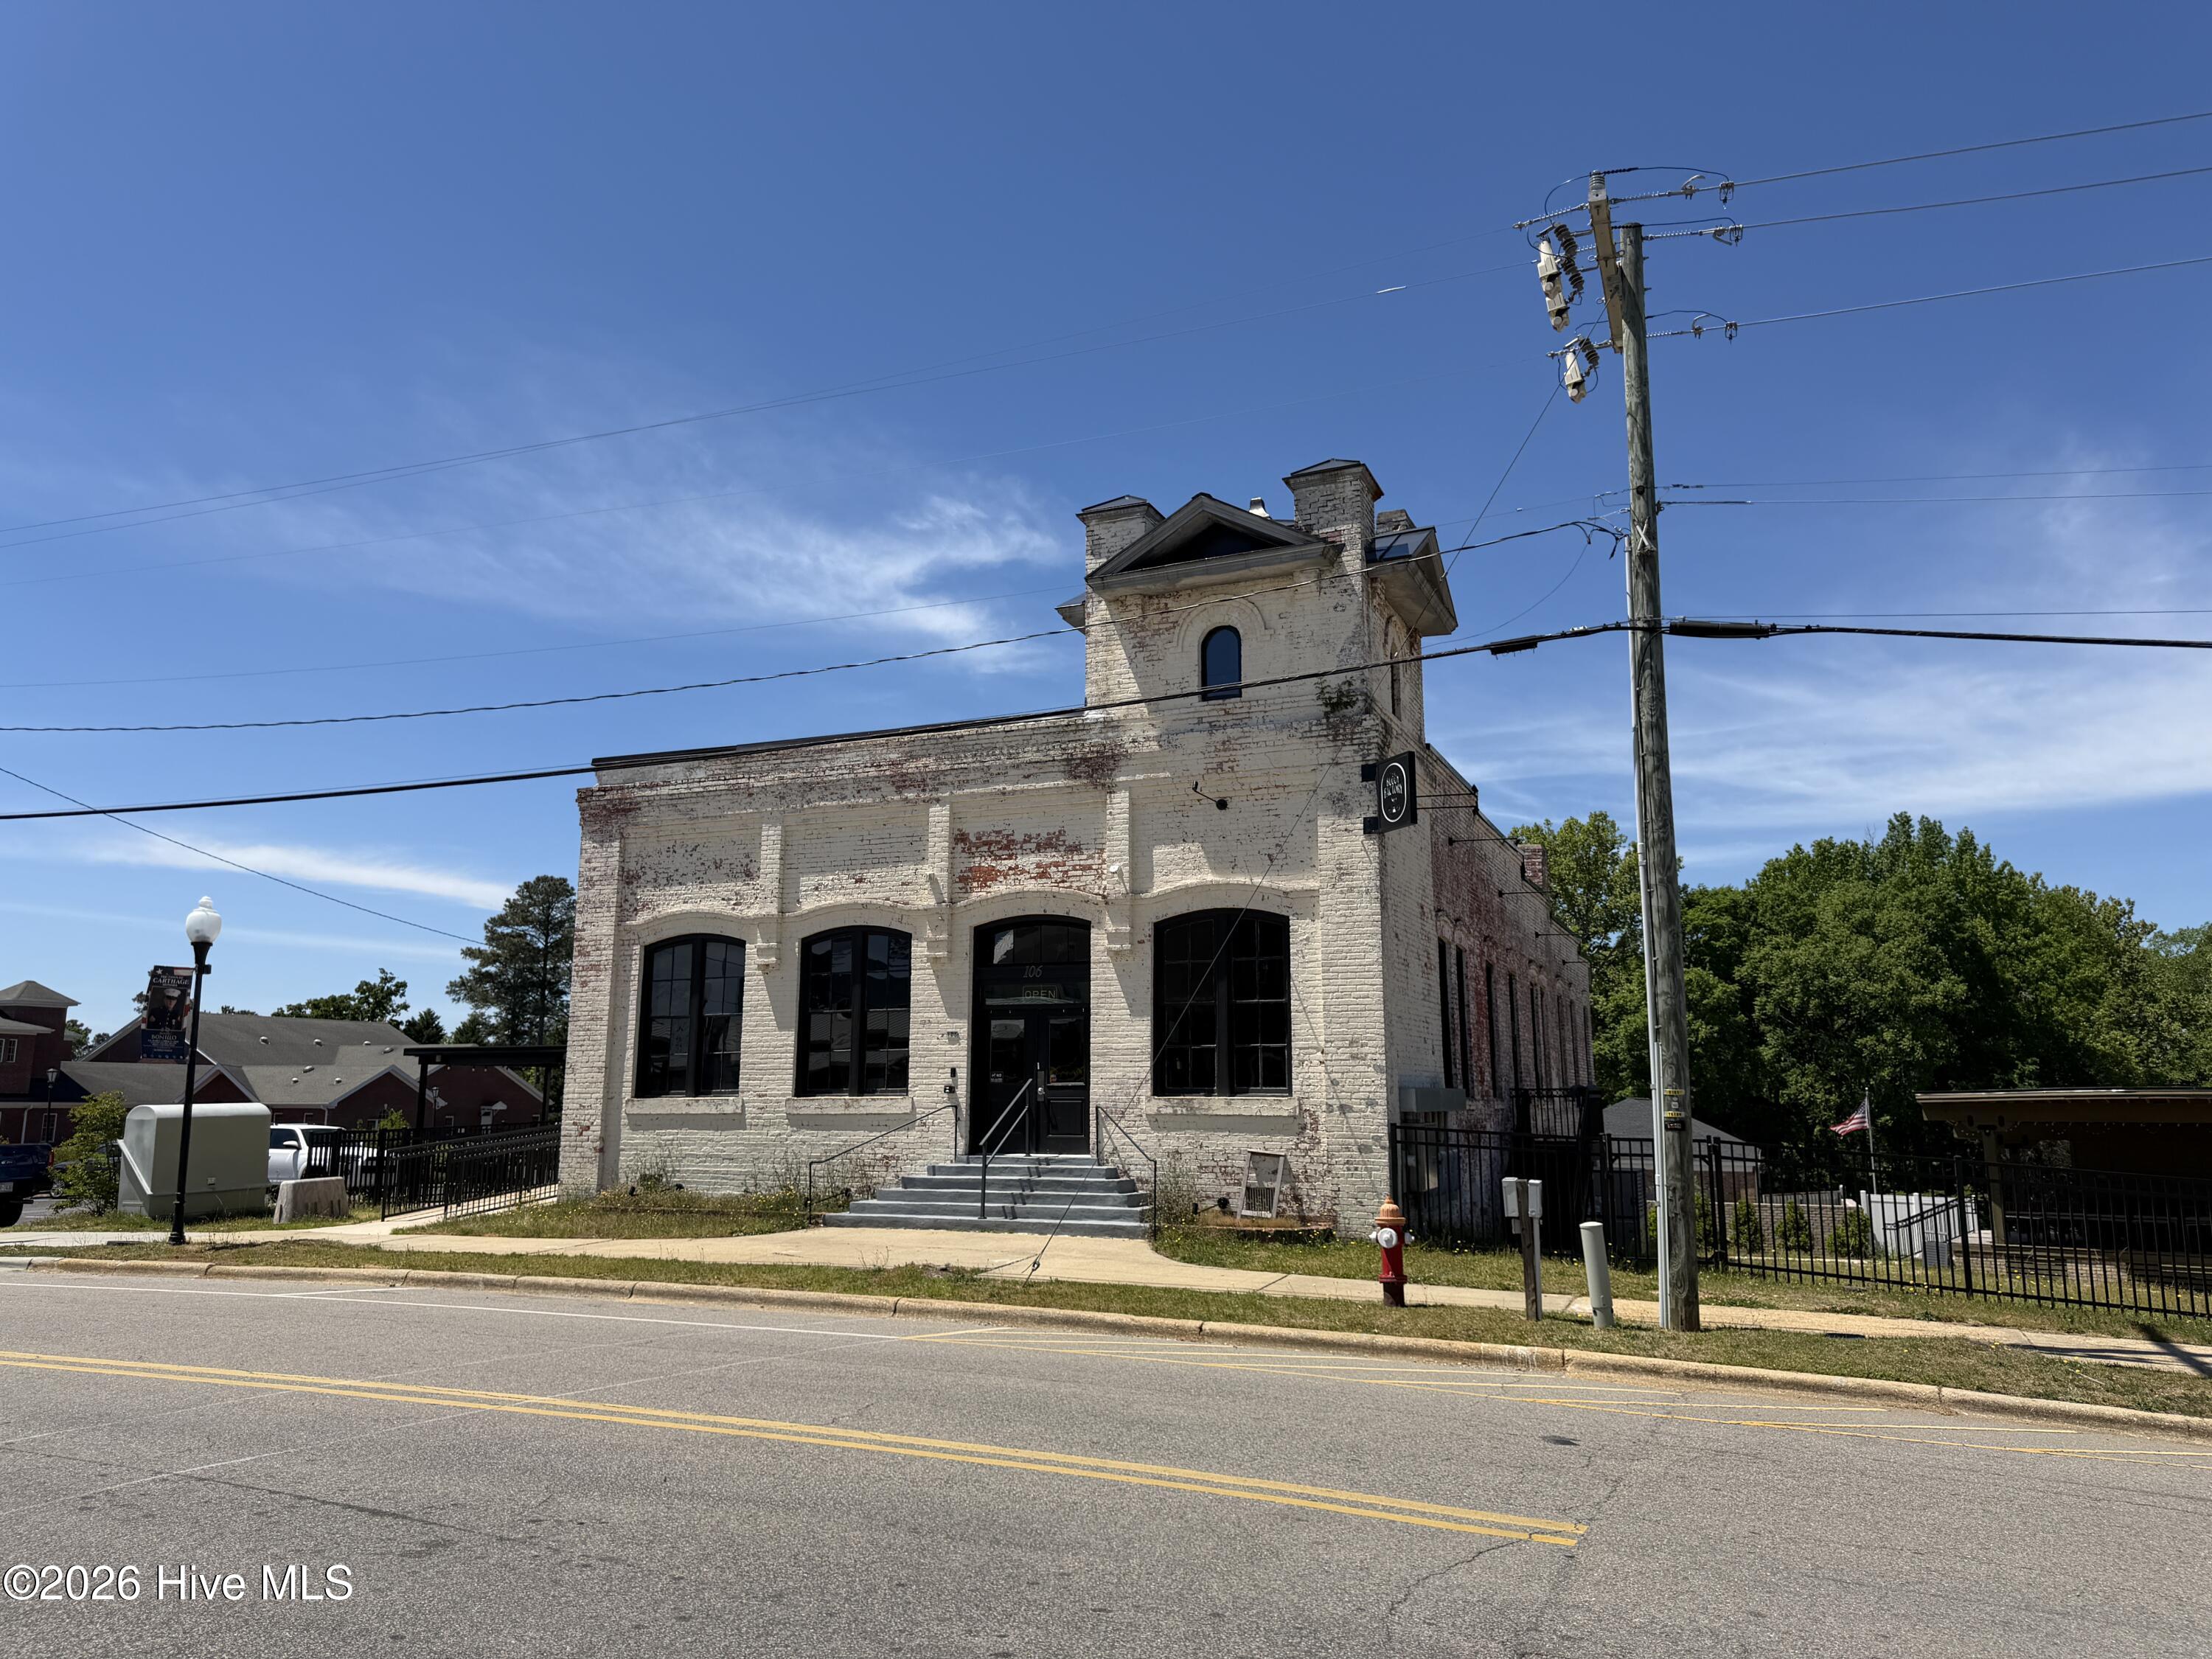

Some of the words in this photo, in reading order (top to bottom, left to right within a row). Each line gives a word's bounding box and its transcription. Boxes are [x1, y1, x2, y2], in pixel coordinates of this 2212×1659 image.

[1023, 965, 1043, 978] 106
[153, 977, 189, 985] CARTHAGE
[1025, 990, 1056, 999] OPEN
